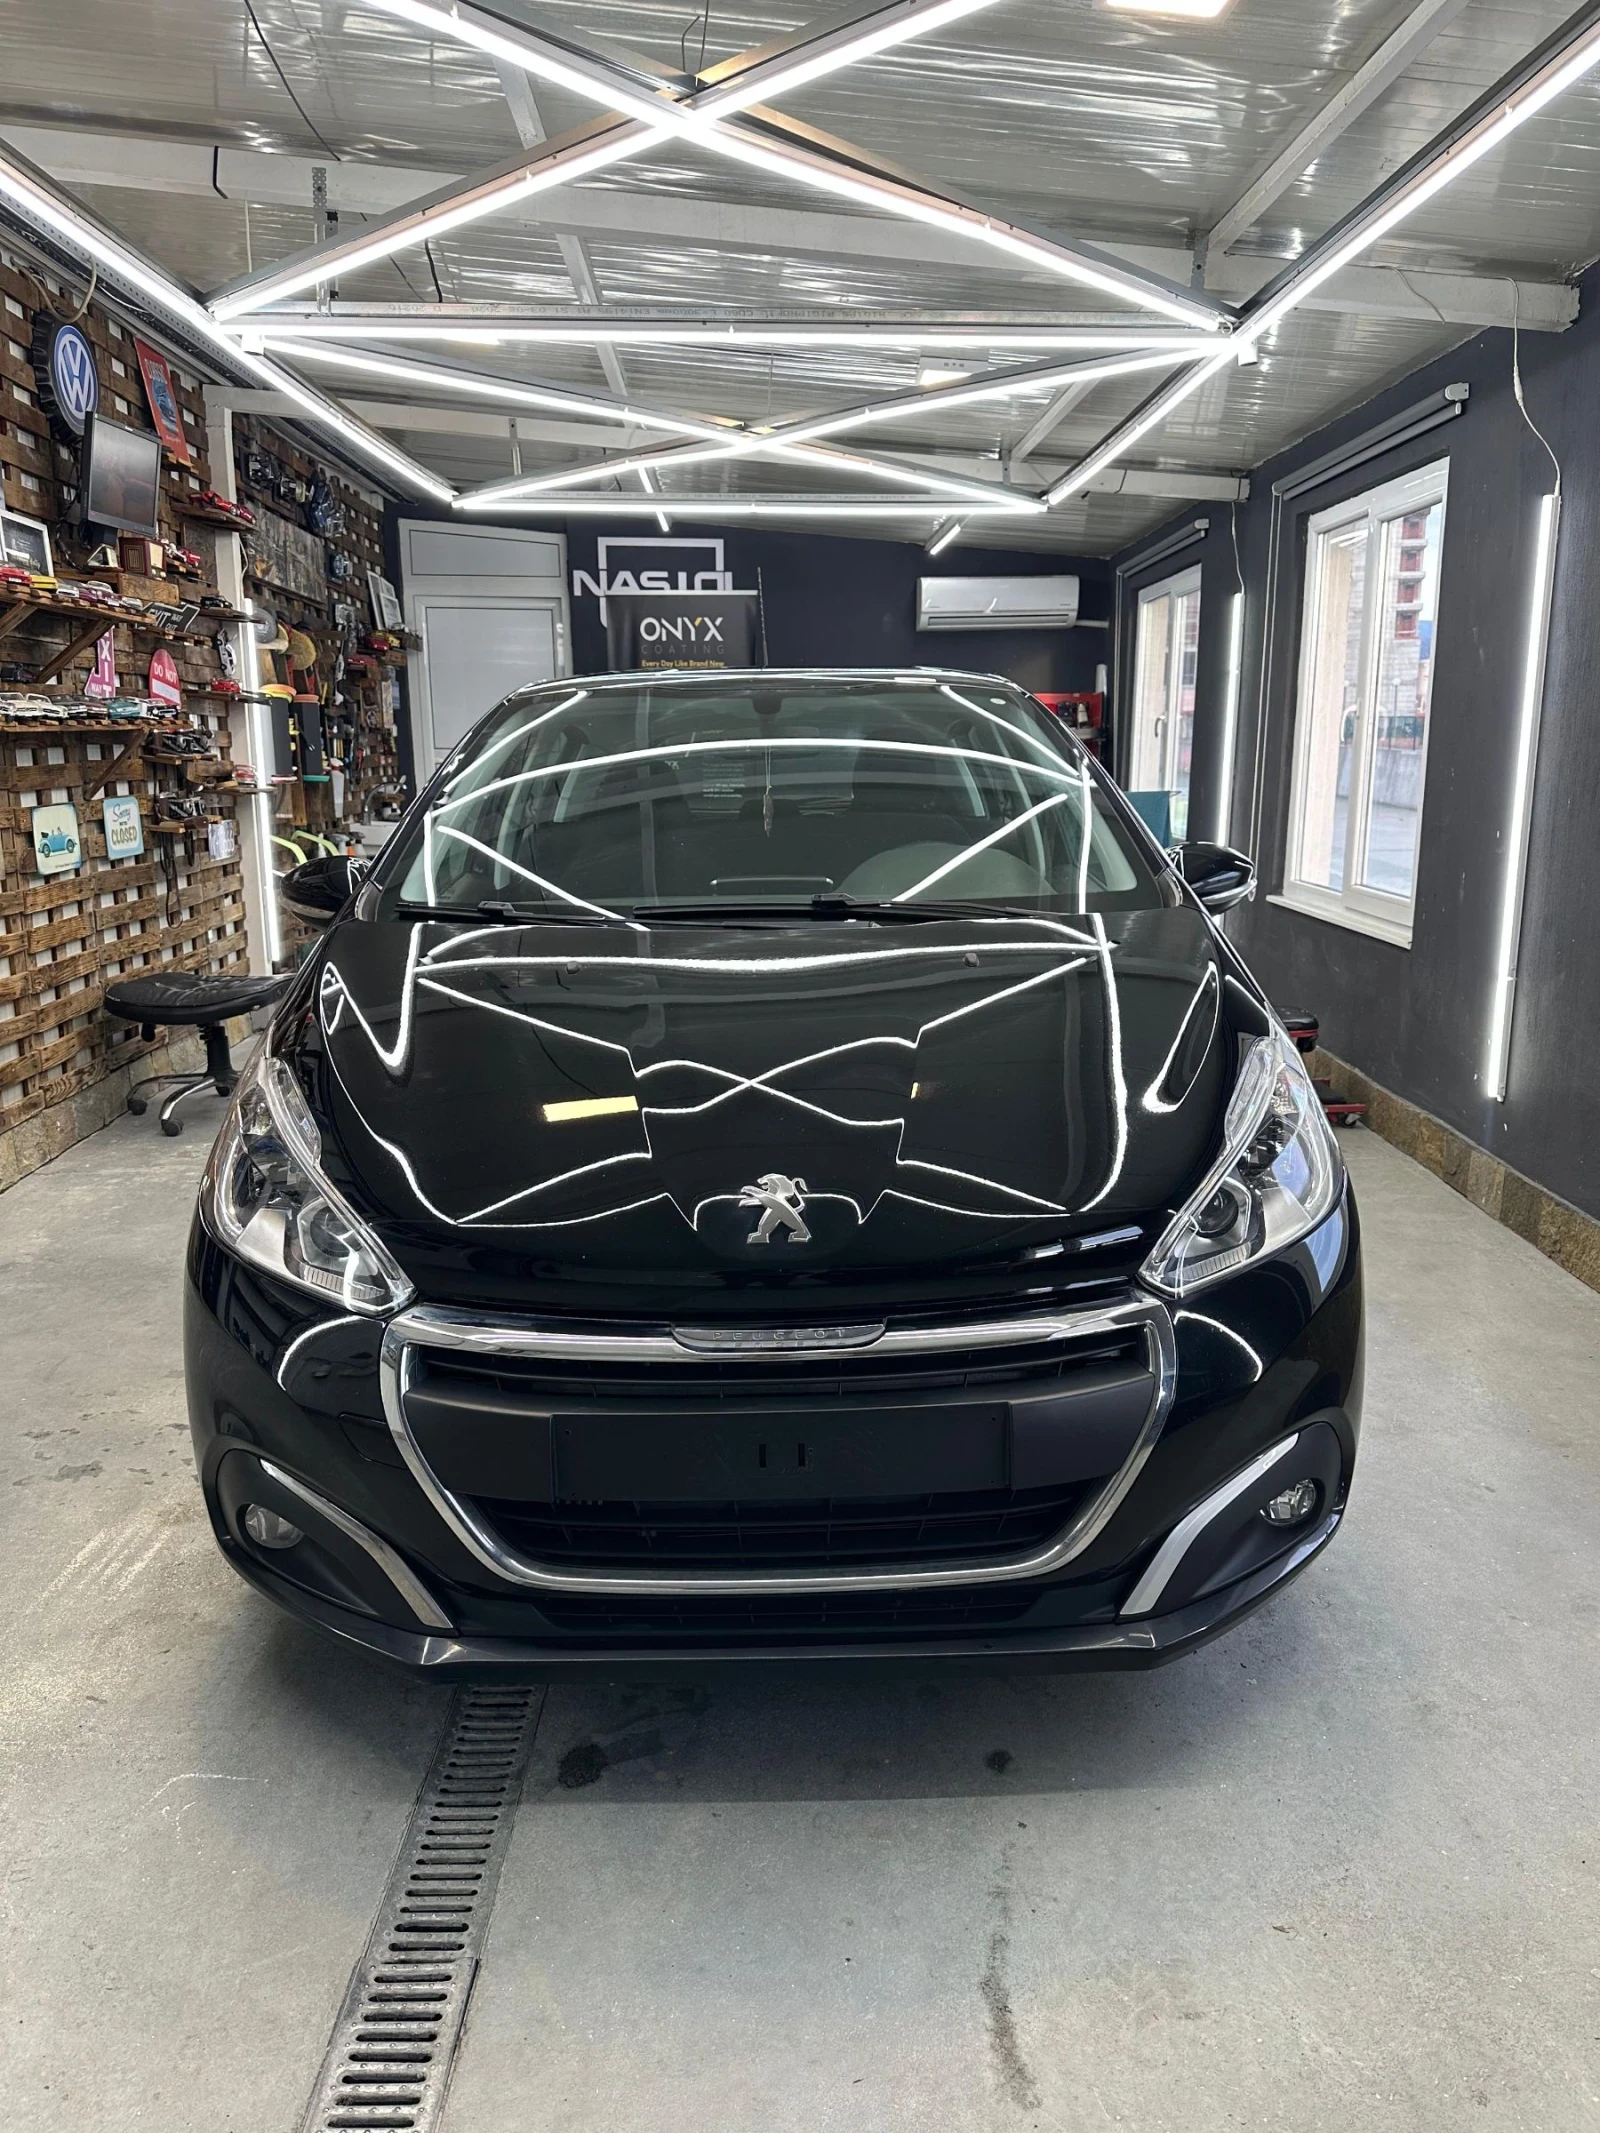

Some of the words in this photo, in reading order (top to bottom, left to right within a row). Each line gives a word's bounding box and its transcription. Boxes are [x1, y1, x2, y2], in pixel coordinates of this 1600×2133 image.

[640, 617, 724, 642] ONYX
[641, 644, 725, 655] COATING
[154, 662, 164, 677] DO
[165, 668, 178, 683] NOT
[642, 660, 660, 668] Every
[660, 660, 674, 669] Day
[674, 660, 689, 668] Like
[689, 660, 709, 668] Brand
[111, 825, 138, 846] CLOSED
[711, 1329, 846, 1341] PEUGEOT
